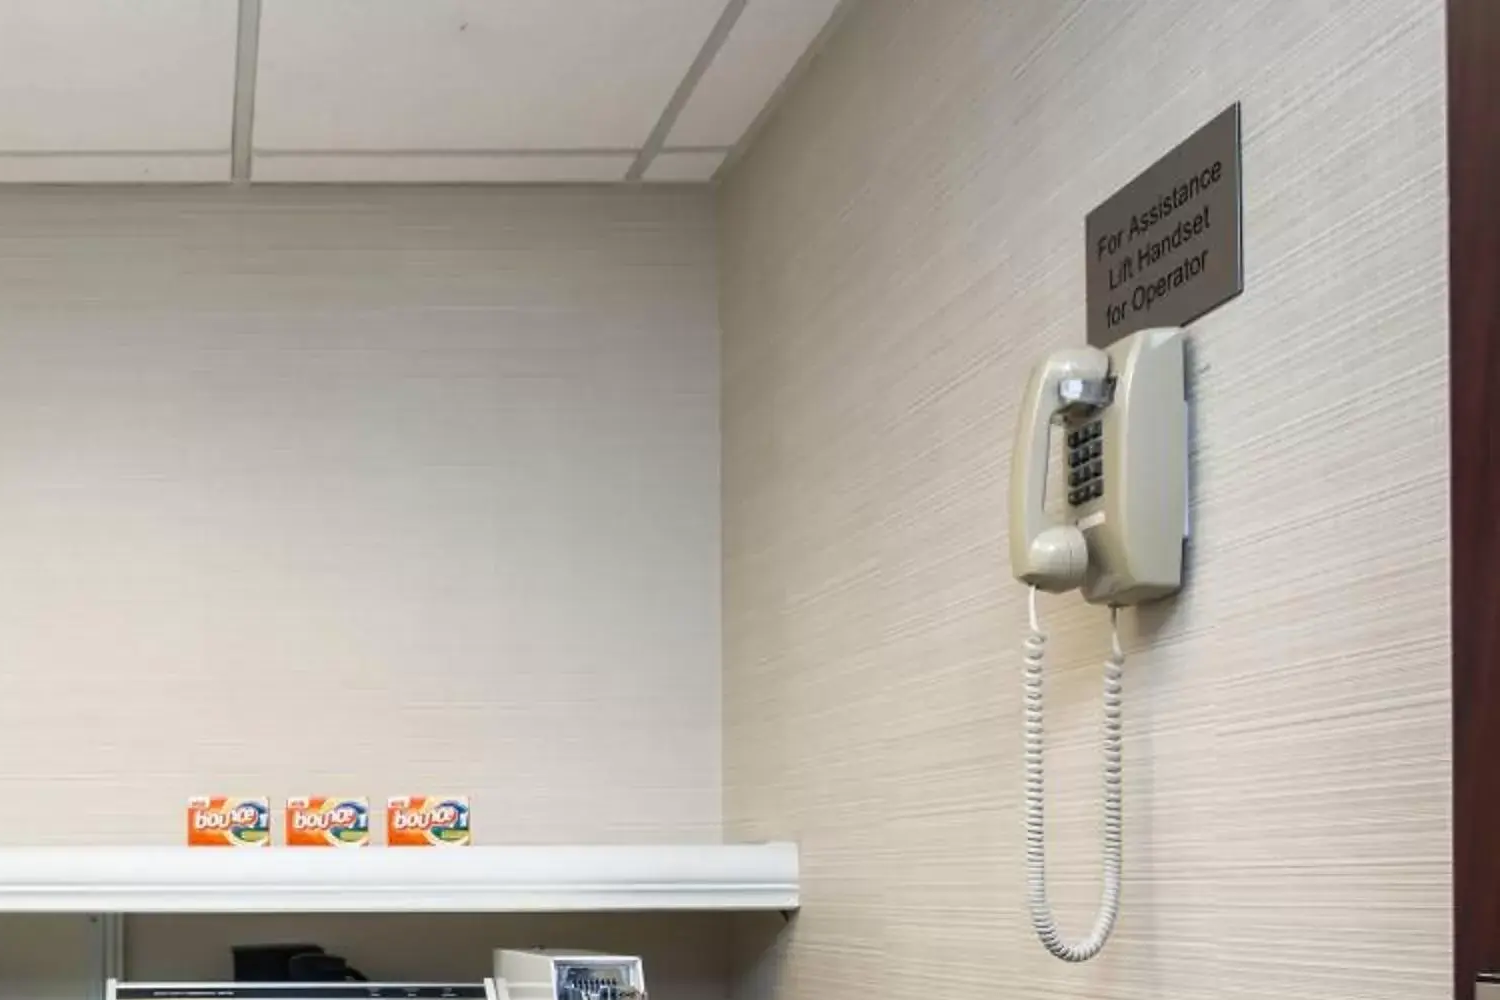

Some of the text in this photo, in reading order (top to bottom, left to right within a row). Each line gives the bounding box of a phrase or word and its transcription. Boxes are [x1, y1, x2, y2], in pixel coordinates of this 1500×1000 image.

[1097, 160, 1222, 260] For Assistance
[1109, 205, 1210, 292] Lift Handset
[1106, 249, 1209, 329] for Operator
